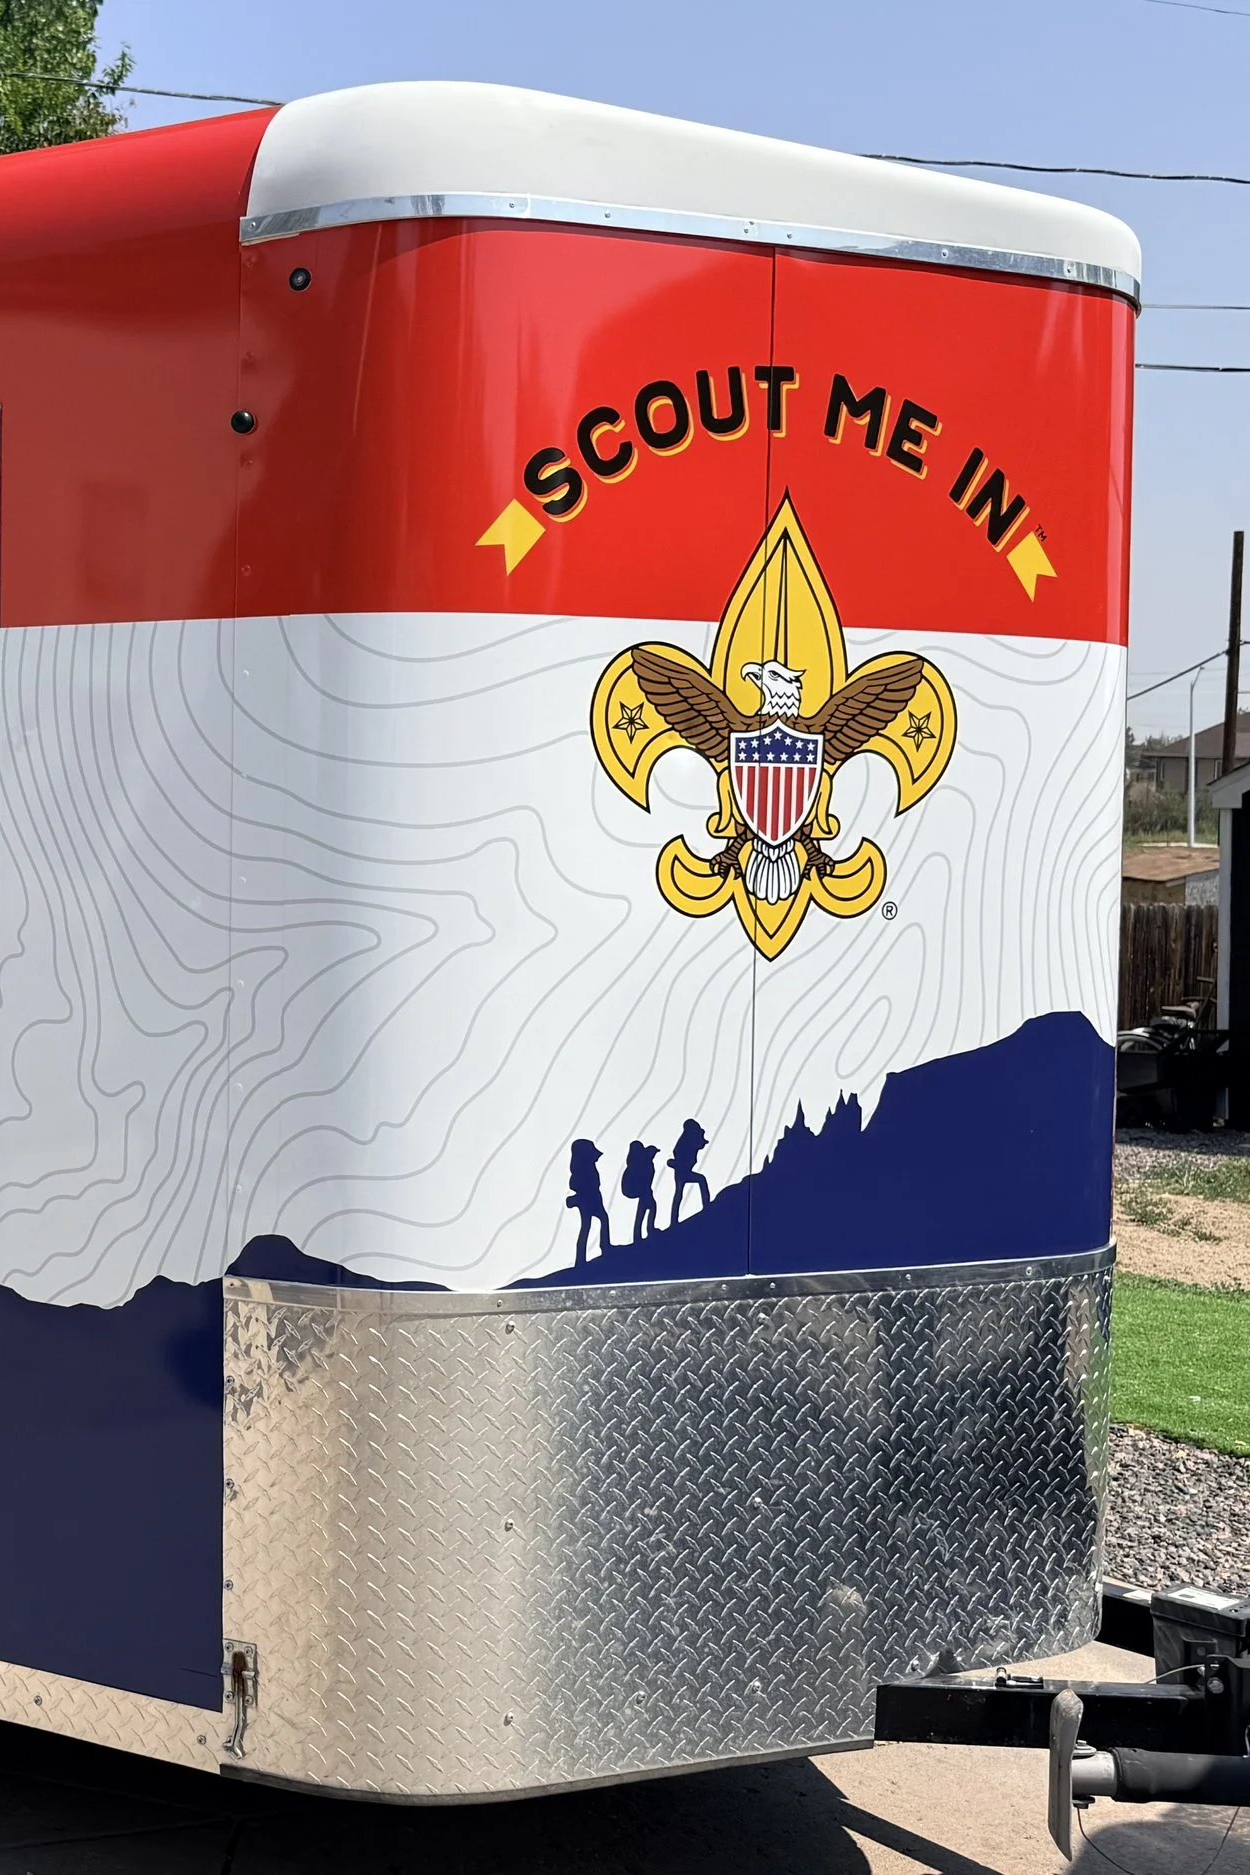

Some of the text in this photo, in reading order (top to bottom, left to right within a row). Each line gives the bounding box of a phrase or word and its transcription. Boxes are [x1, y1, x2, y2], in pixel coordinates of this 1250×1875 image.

[523, 365, 799, 522] SCOUT
[824, 373, 943, 480] ME
[949, 447, 1030, 553] IN
